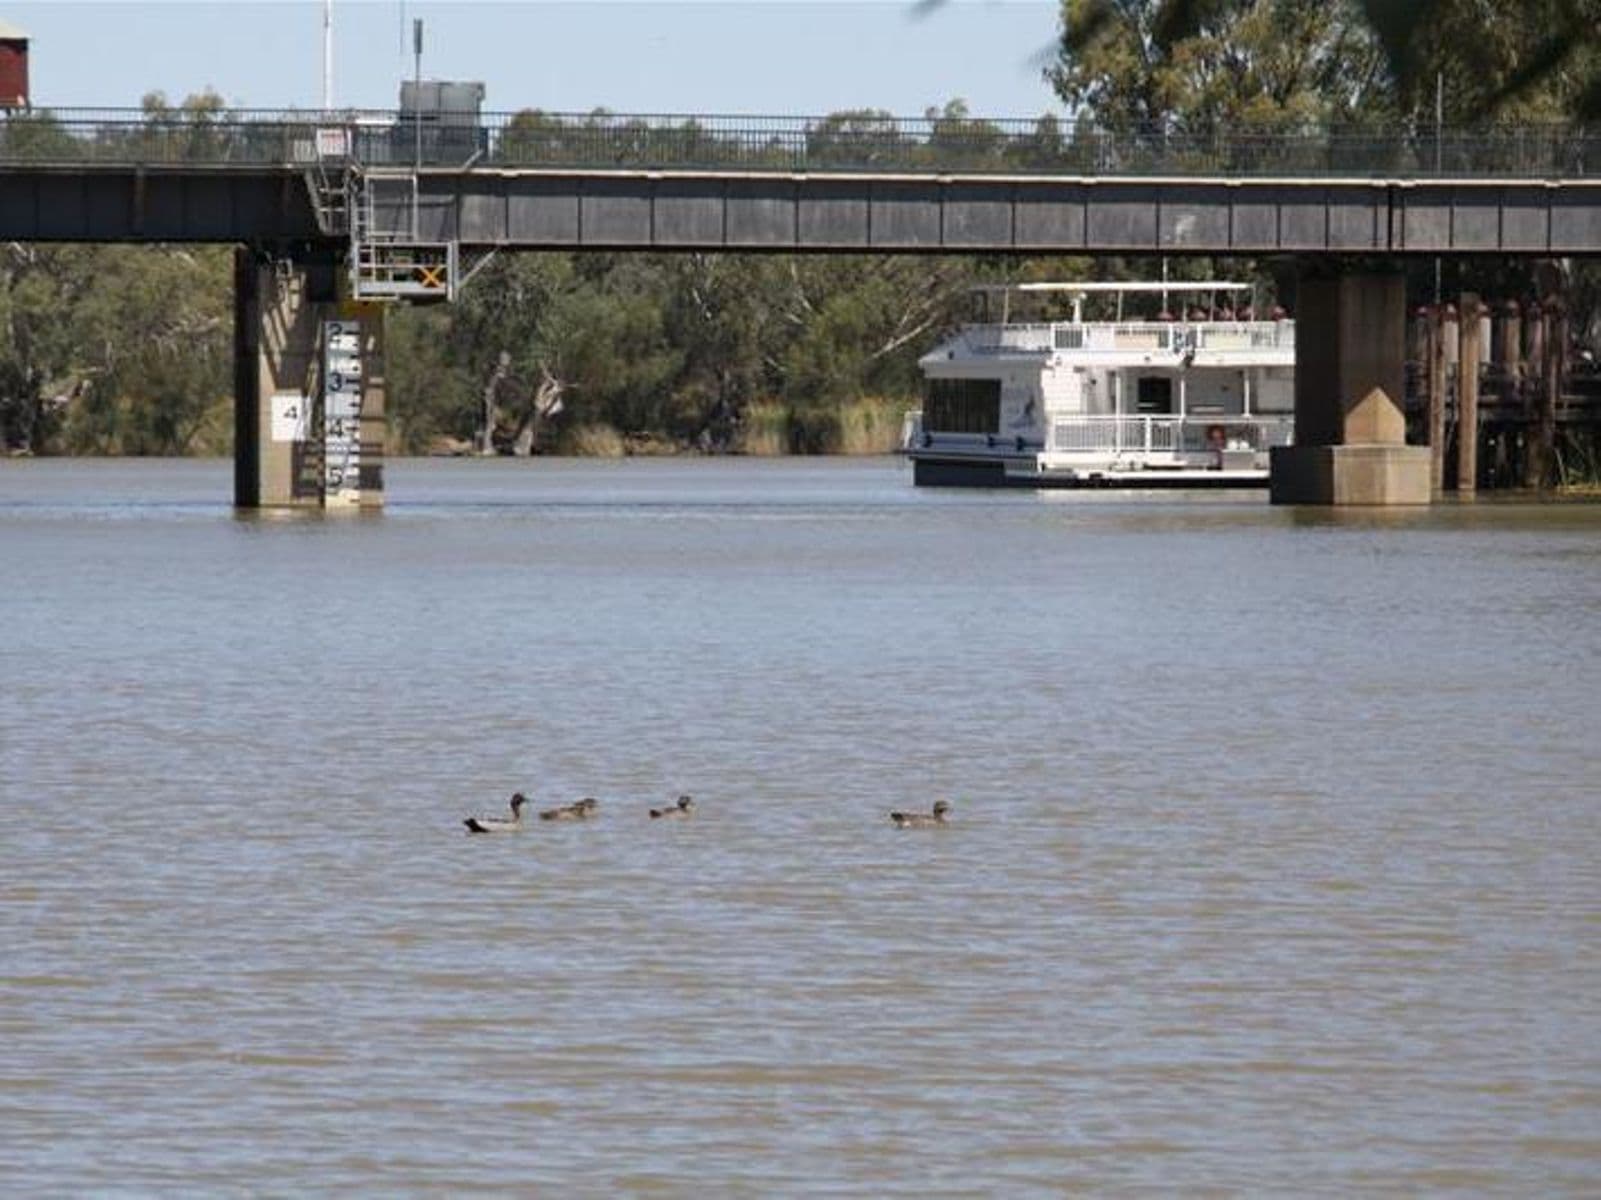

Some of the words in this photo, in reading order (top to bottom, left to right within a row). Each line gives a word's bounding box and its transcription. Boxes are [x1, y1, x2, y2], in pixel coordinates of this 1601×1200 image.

[328, 323, 342, 342] 2
[328, 372, 342, 391] 3
[283, 405, 297, 419] 4
[328, 418, 343, 437] 4
[328, 467, 342, 487] 5
